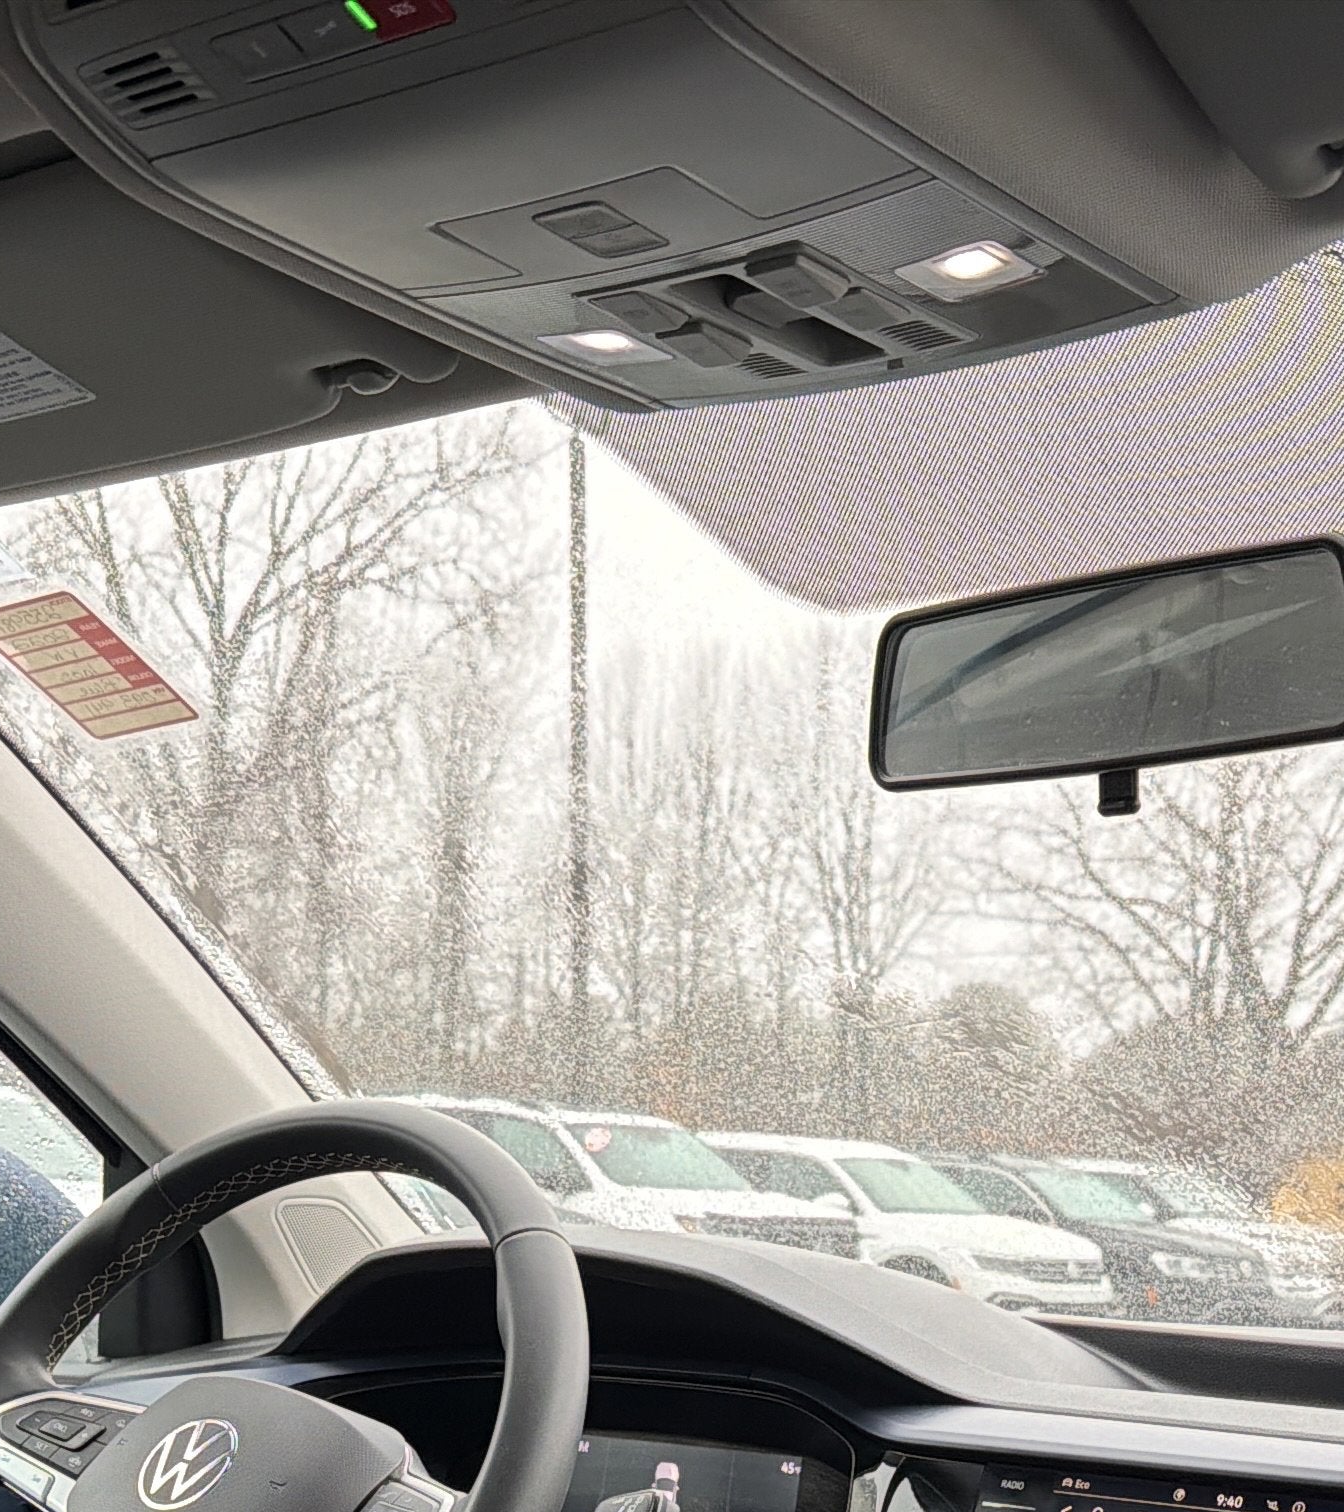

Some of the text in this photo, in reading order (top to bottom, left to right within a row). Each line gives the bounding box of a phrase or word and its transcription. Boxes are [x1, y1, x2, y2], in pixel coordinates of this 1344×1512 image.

[1000, 1479, 1025, 1490] RADIO
[1074, 1478, 1091, 1490] Eco
[1216, 1493, 1243, 1509] 9:40
